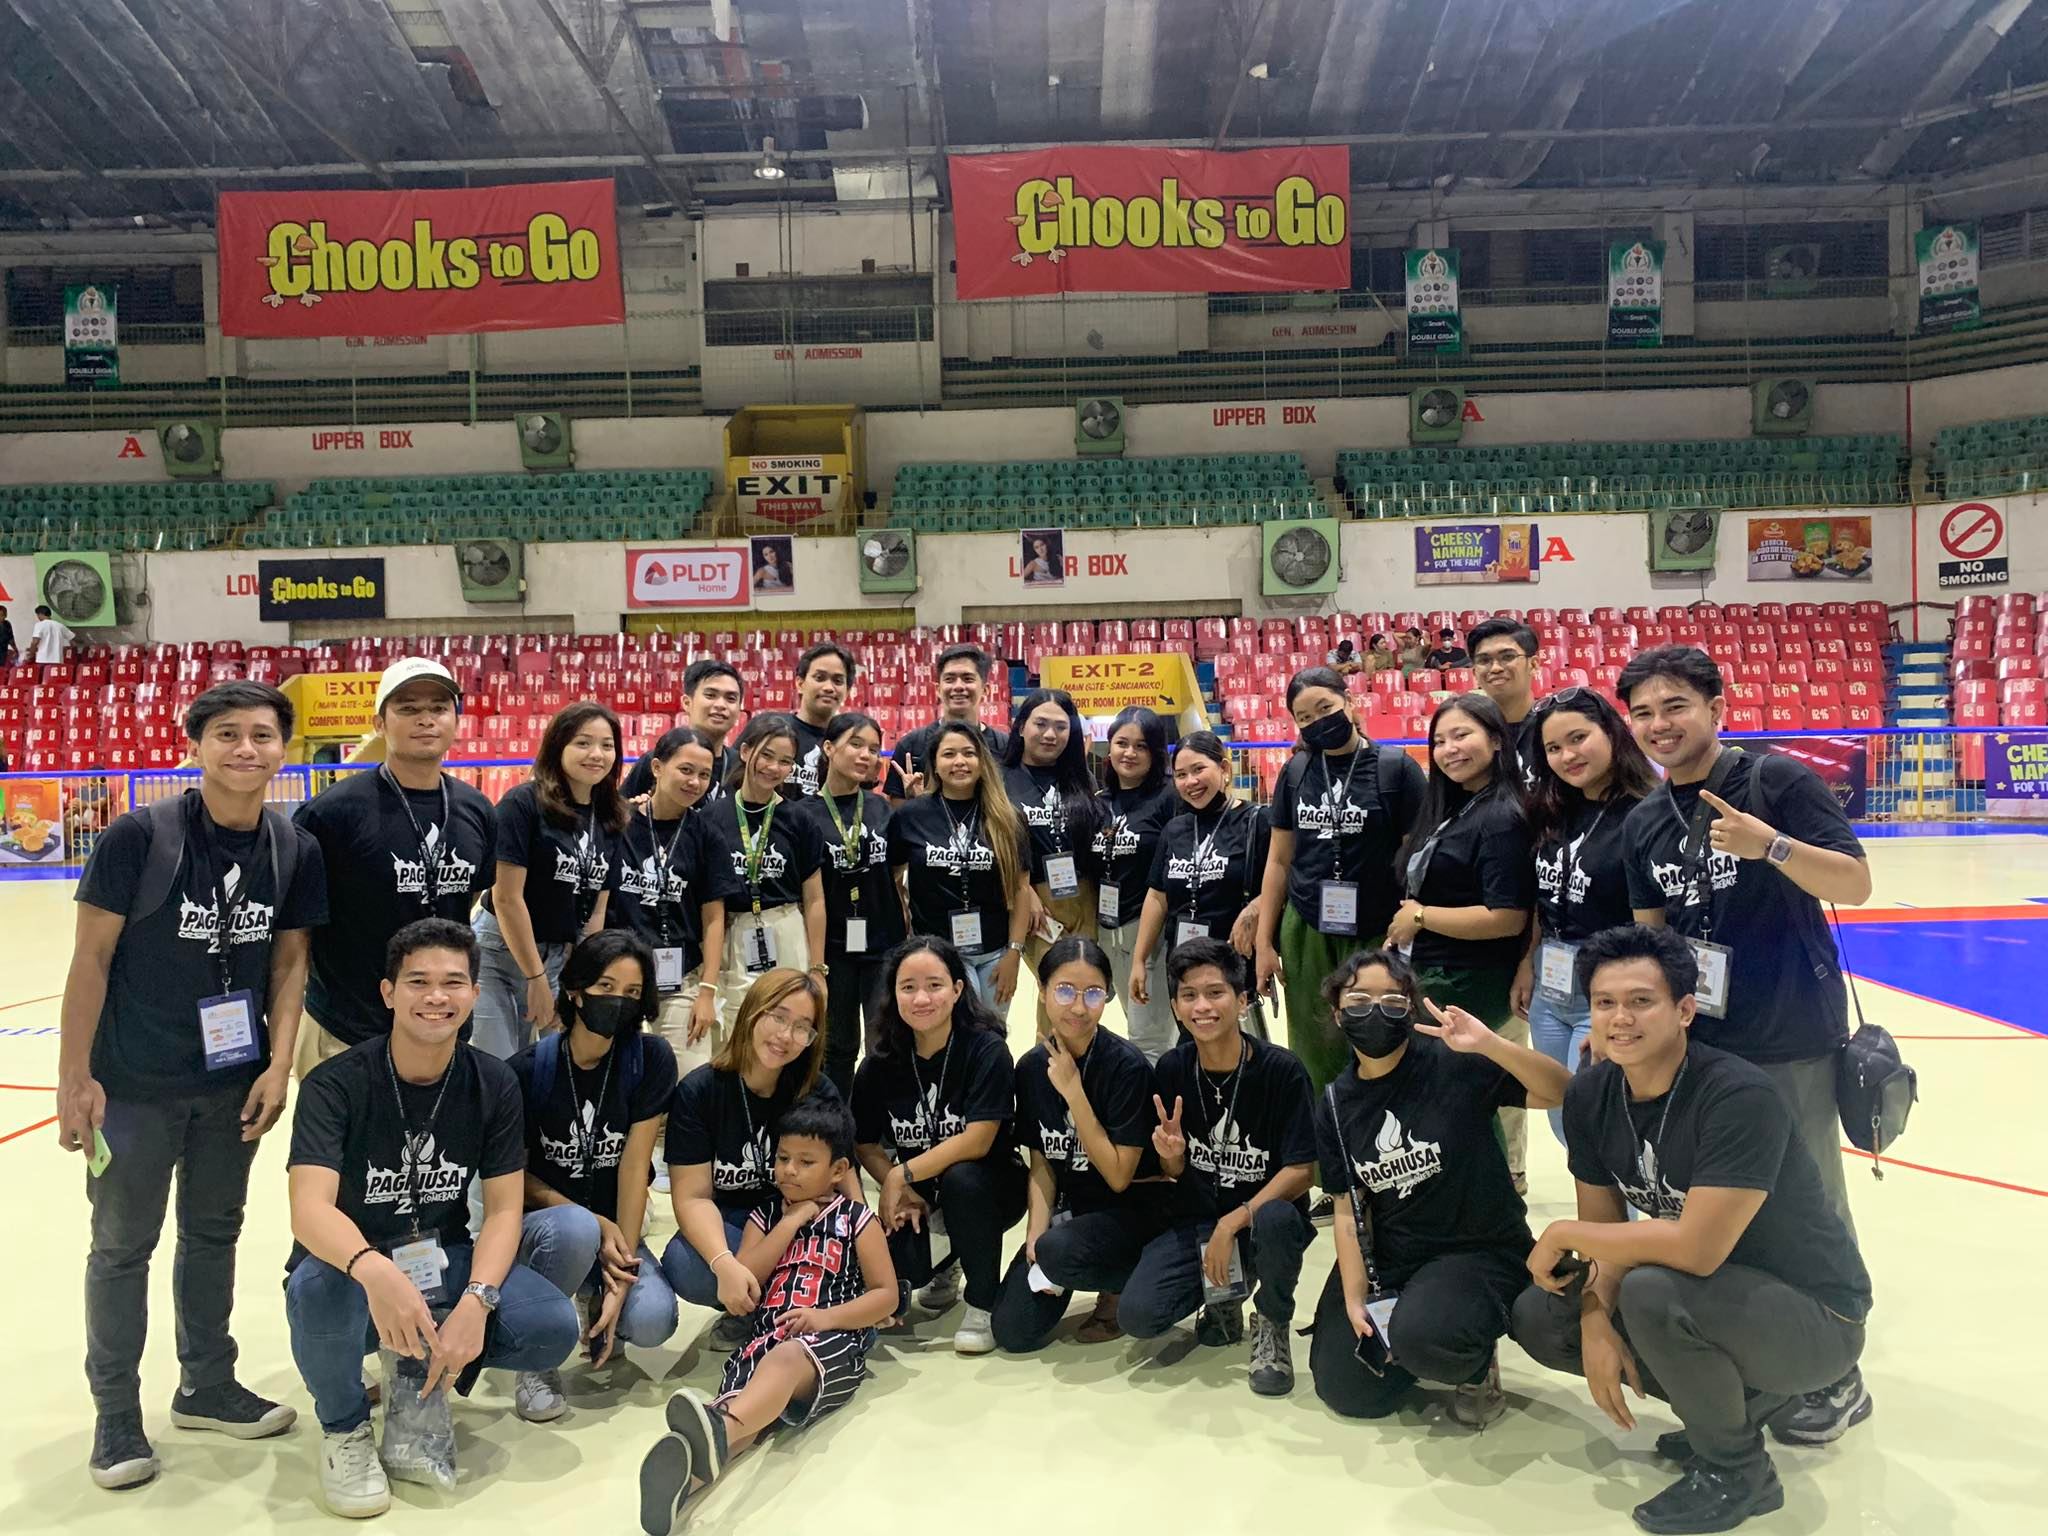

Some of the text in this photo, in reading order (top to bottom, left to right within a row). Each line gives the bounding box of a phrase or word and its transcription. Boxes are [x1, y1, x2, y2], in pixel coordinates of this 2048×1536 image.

[1014, 176, 1346, 255] Chooks to Go
[266, 213, 601, 297] Chooks to Go
[1302, 324, 1357, 336] ADMISSION
[804, 347, 863, 359] ADMISSION
[1212, 405, 1317, 428] UPPER BOX
[1461, 400, 1485, 422] A
[117, 437, 146, 458] A
[311, 430, 414, 452] UPPER BOX
[752, 460, 821, 469] NO SMOKING
[737, 475, 838, 496] EXIT
[761, 502, 817, 511] THIS WAY
[1430, 532, 1484, 546] CHEESY
[1432, 546, 1483, 559] NAMNAM
[1539, 536, 1575, 562] A
[1088, 554, 1128, 576] BOX
[1434, 559, 1447, 568] FOR
[1449, 558, 1464, 567] THE
[1959, 561, 1984, 573] NO
[673, 564, 730, 582] PLDT
[1940, 571, 2008, 586] SMOKING
[272, 576, 376, 602] Chooks to Go
[698, 584, 727, 593] Home
[1071, 662, 1155, 679] EXIT-2
[1093, 696, 1115, 708] ROOM
[1122, 695, 1157, 706] CANTEEN
[308, 716, 343, 727] COMFORT
[345, 715, 366, 725] ROOM
[2013, 782, 2035, 793] FOR
[1072, 1157, 1089, 1171] 22
[1192, 1145, 1264, 1171] PAGHIUSA
[1360, 1147, 1438, 1185] PAGHIUSA
[1219, 1172, 1236, 1189] 22
[763, 1265, 825, 1308] 23
